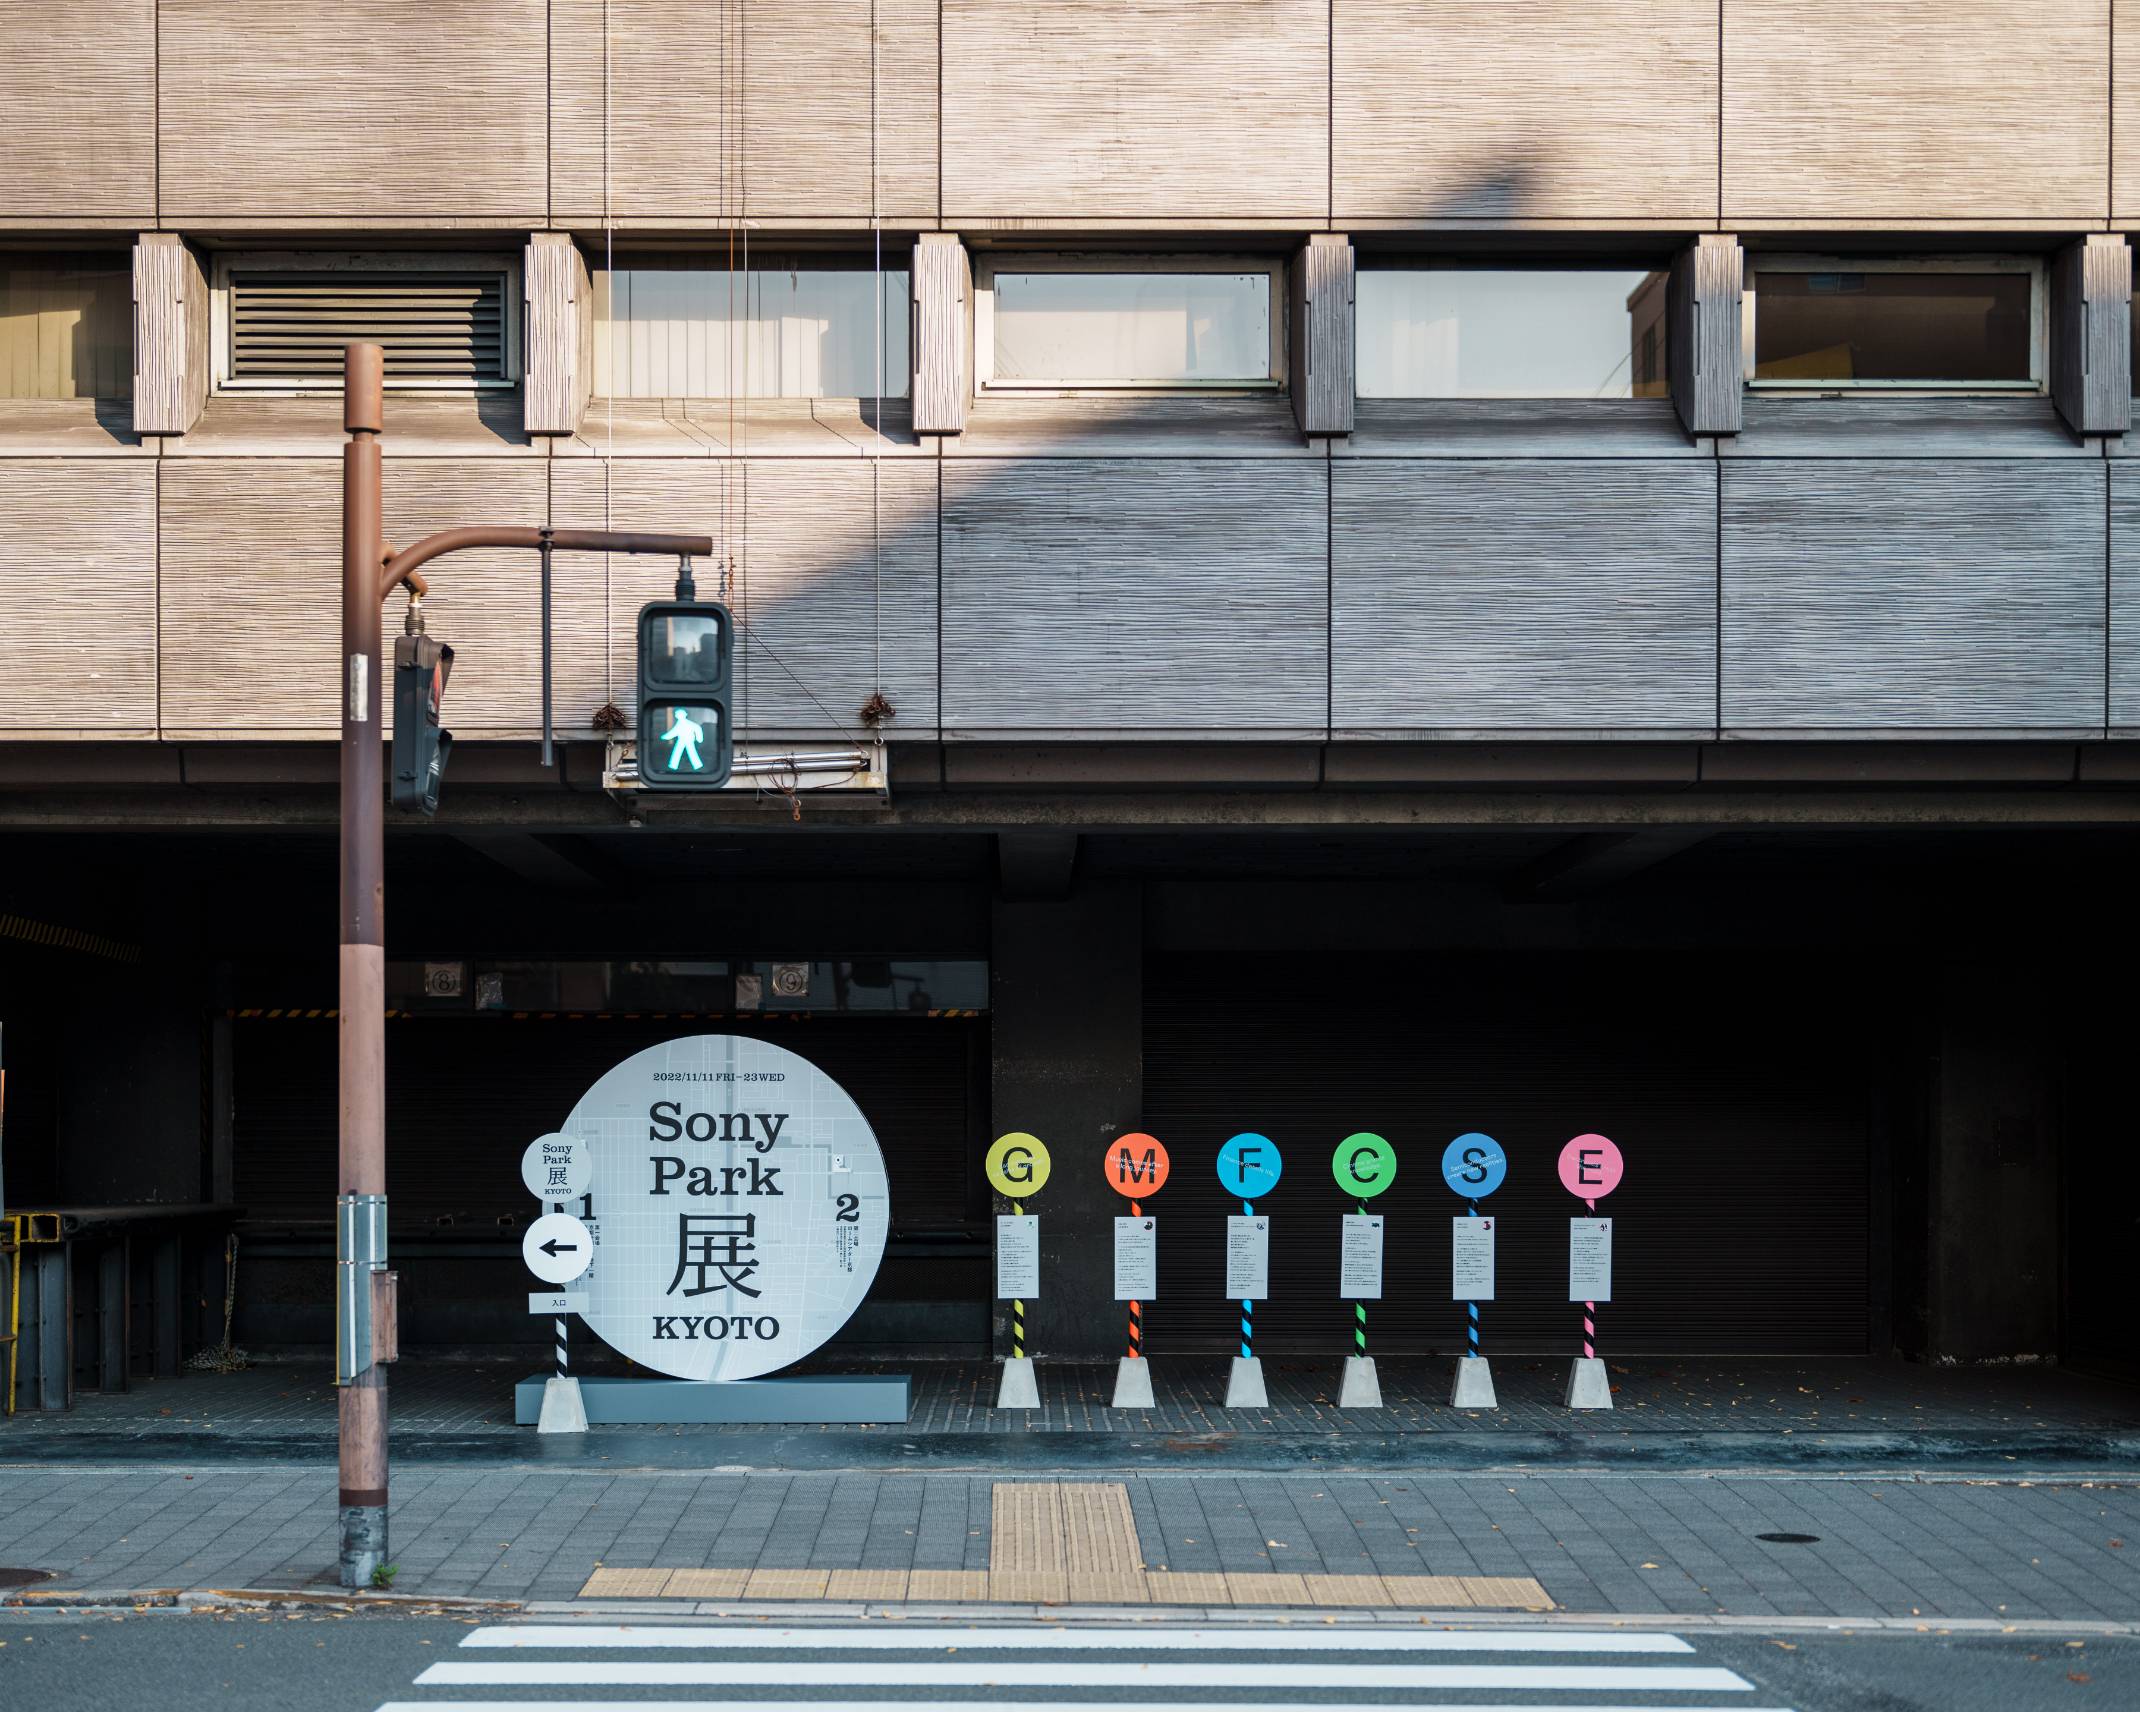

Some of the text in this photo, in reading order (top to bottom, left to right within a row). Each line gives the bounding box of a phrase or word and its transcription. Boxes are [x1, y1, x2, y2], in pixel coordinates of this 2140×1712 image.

[649, 1100, 789, 1154] Sony
[542, 1143, 573, 1155] Sony
[543, 1155, 573, 1164] Park
[1001, 1146, 1033, 1183] G
[1119, 1148, 1155, 1184] M
[1238, 1148, 1262, 1183] F
[1349, 1147, 1379, 1184] C
[1461, 1147, 1488, 1184] S
[1578, 1149, 1604, 1185] E
[547, 1167, 568, 1186] 展
[649, 1157, 784, 1197] Park
[835, 1193, 860, 1222] 2
[666, 1213, 762, 1299] 展
[552, 1299, 567, 1307] 入口
[652, 1315, 780, 1341] KYOTO
